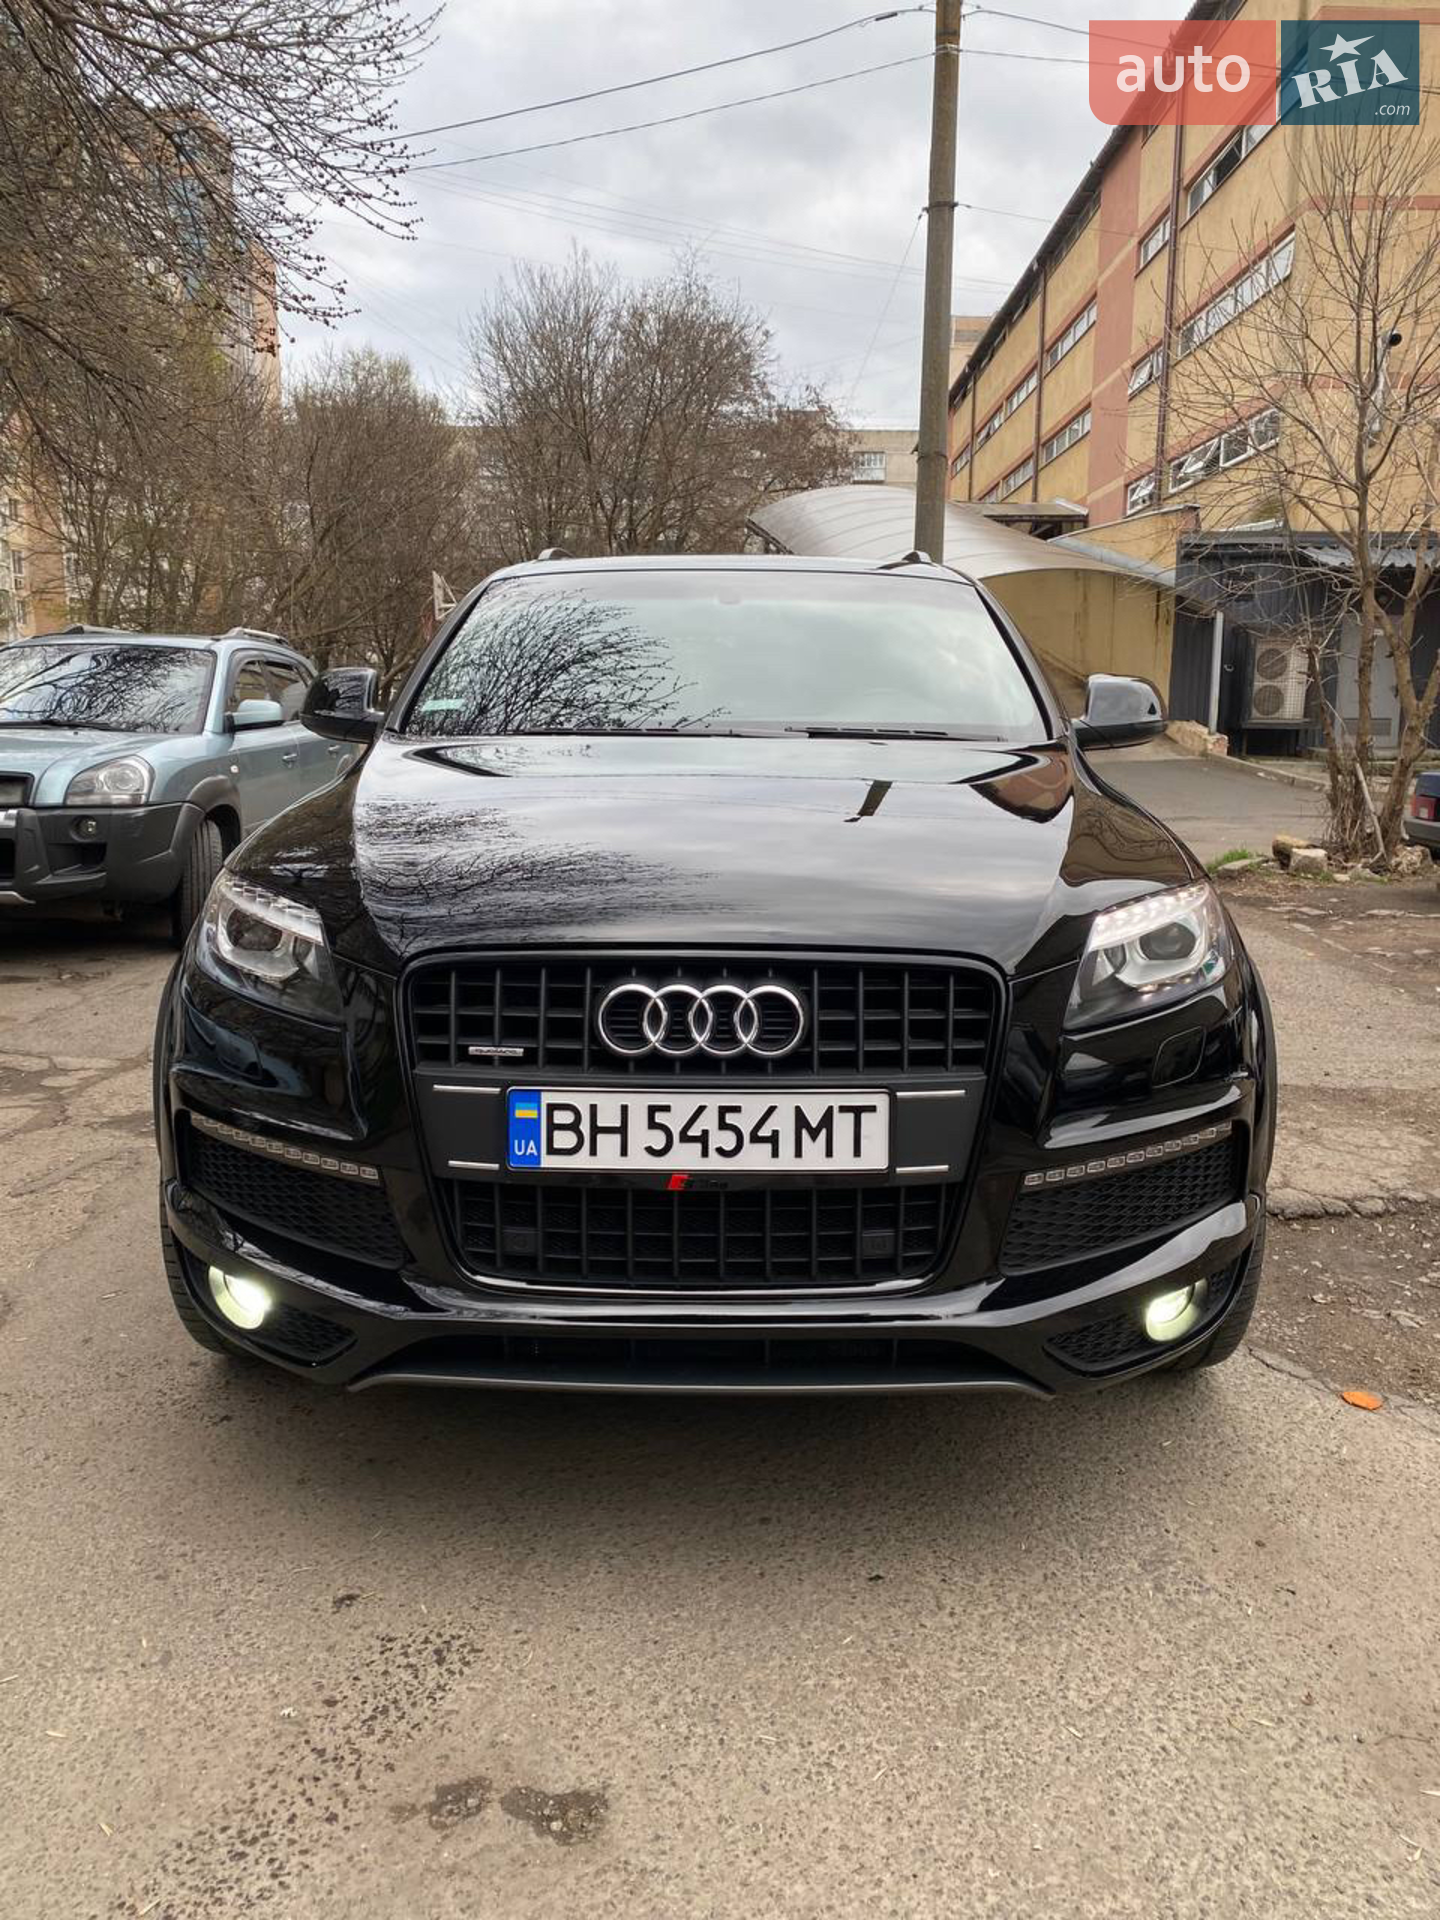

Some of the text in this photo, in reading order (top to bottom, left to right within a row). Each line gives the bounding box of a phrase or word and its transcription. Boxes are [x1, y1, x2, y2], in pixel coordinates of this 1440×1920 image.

[514, 1139, 538, 1156] UA
[546, 1103, 877, 1158] BH 5454 MT
